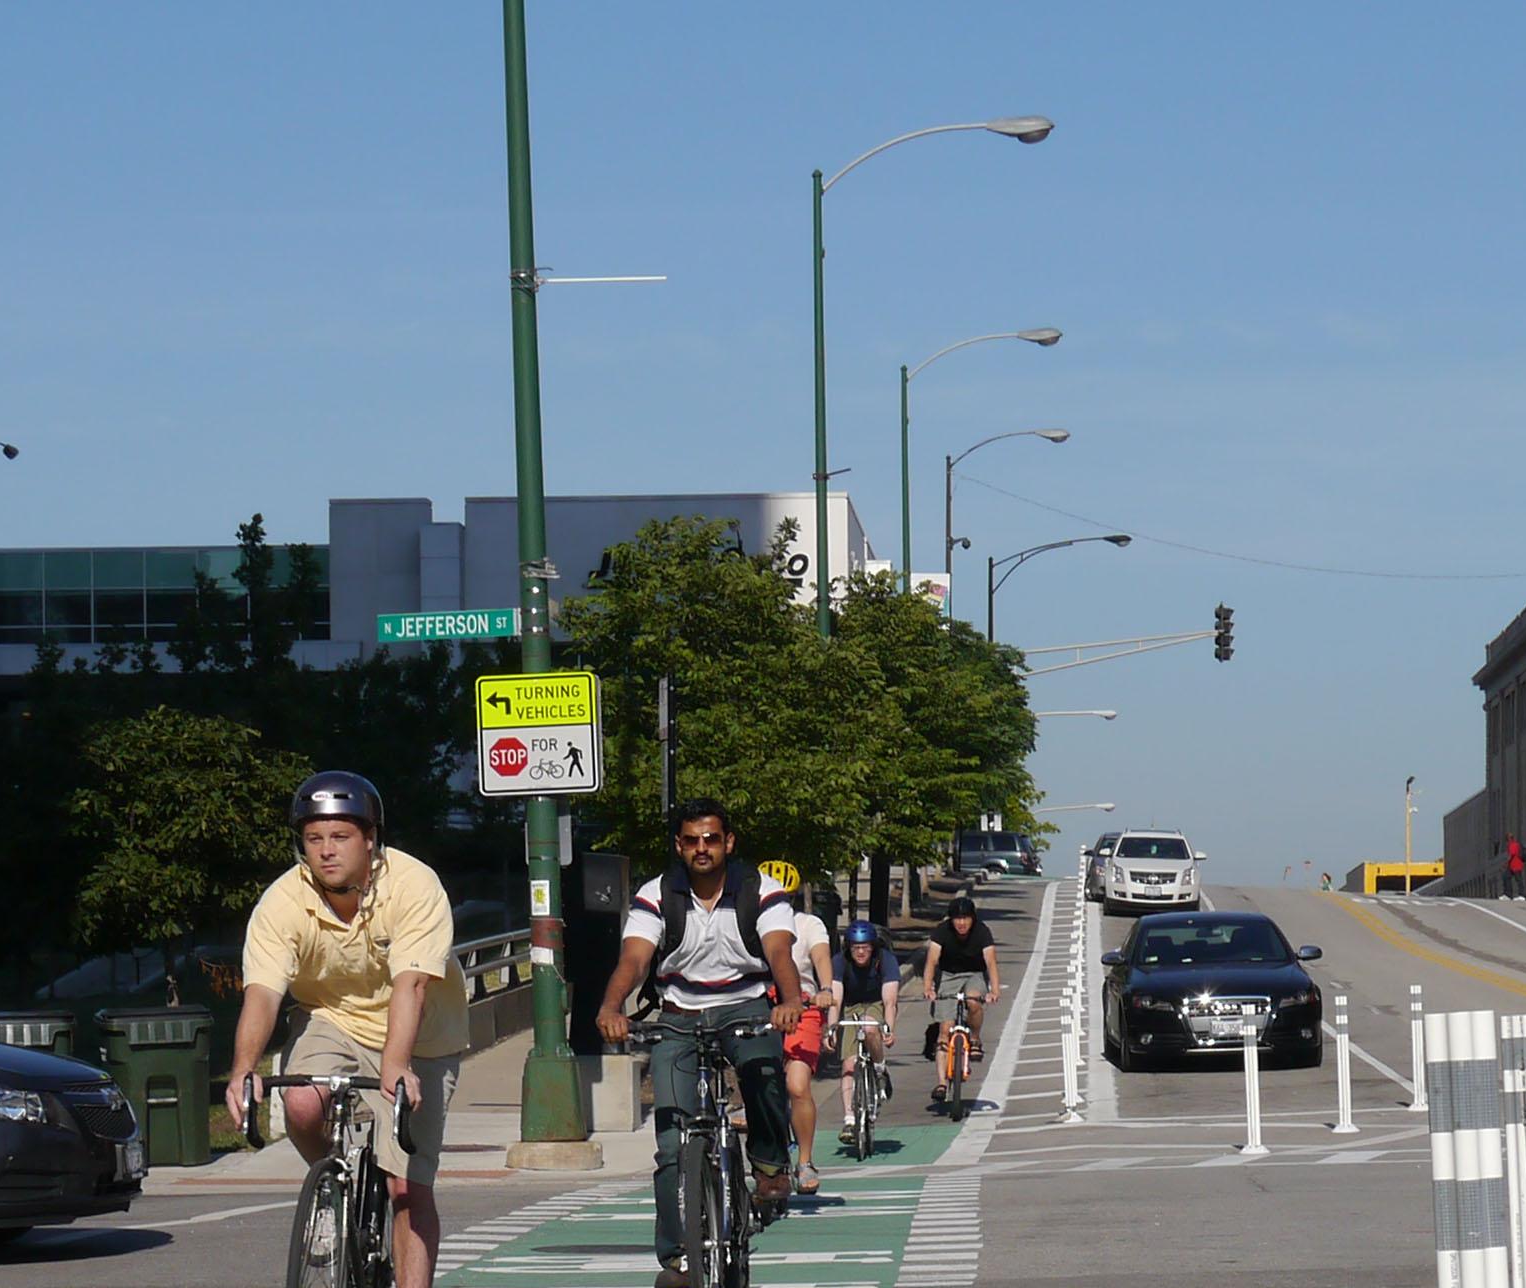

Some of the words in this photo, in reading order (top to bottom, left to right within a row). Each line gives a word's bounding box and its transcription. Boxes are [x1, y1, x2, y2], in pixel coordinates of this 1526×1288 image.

[384, 622, 392, 635] N
[396, 613, 489, 638] JEFFERSON
[495, 616, 508, 629] ST
[515, 684, 580, 700] TURNING
[515, 704, 586, 720] VEHICLES
[531, 738, 558, 752] FOR
[490, 748, 527, 767] STOP
